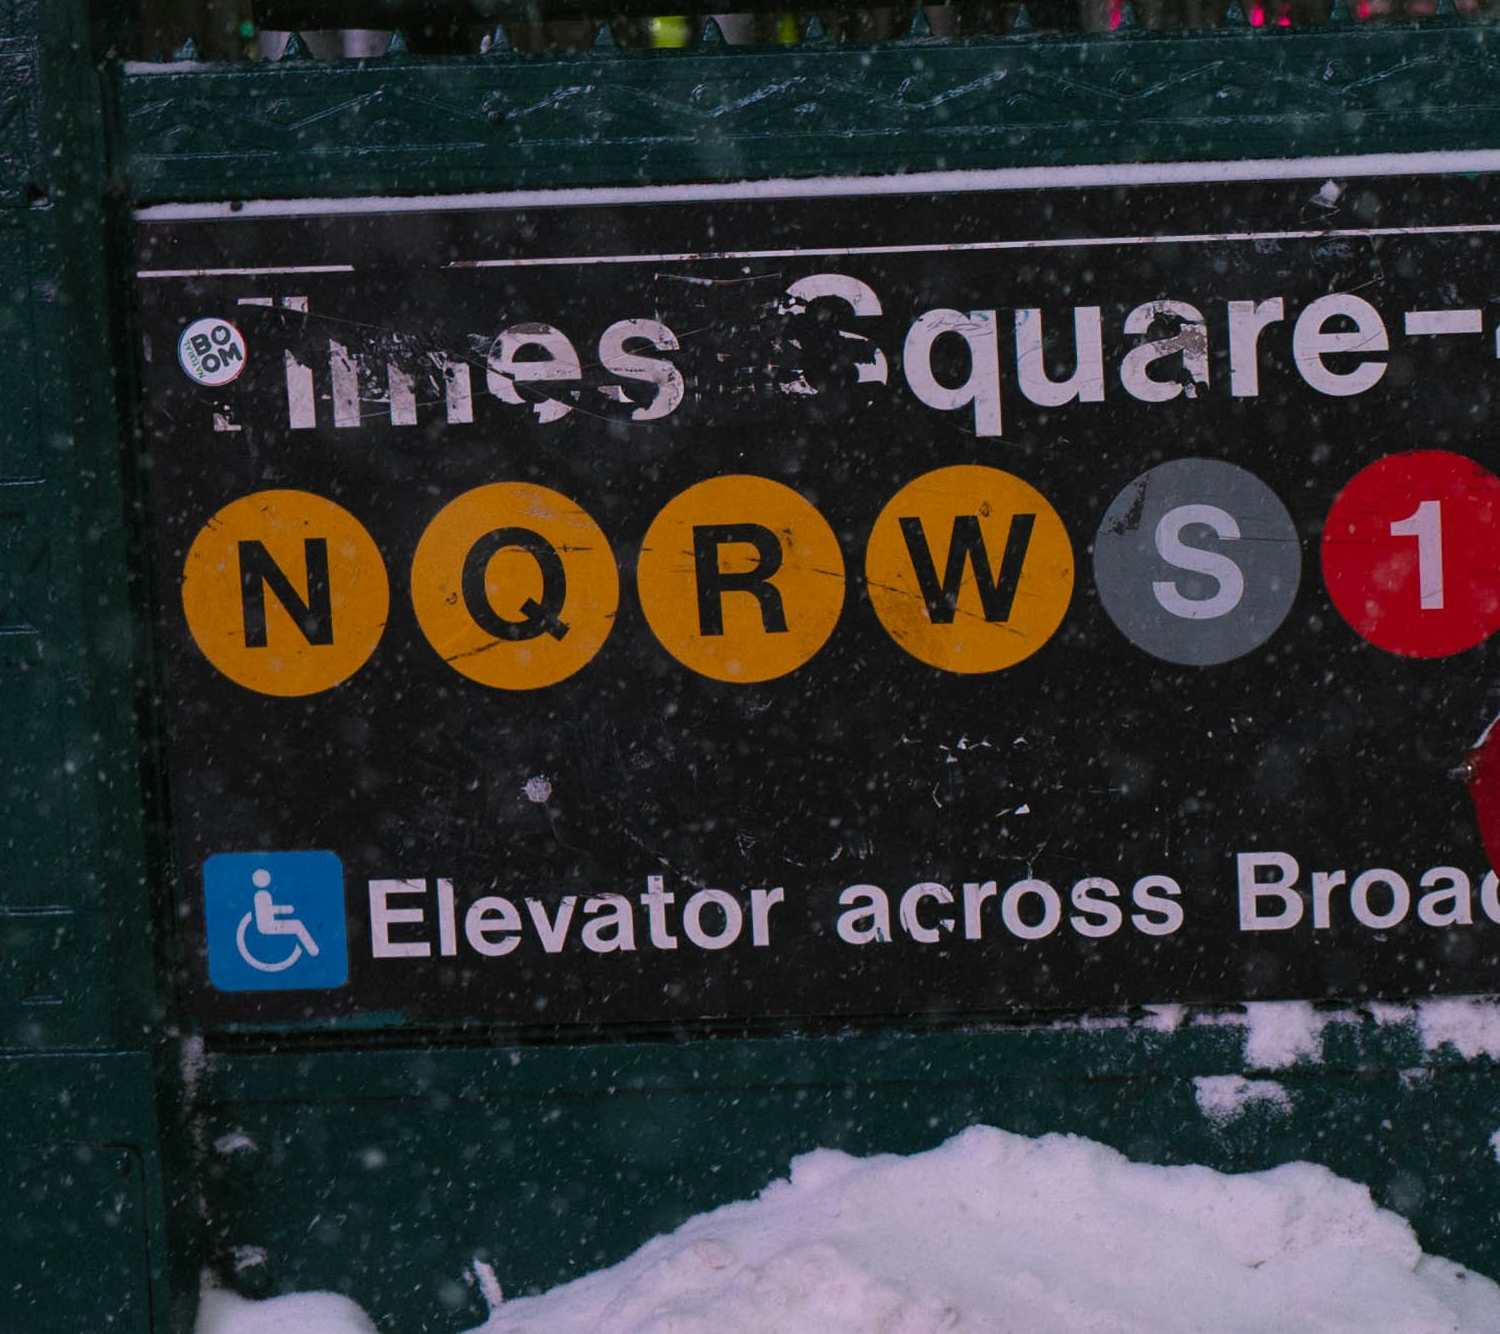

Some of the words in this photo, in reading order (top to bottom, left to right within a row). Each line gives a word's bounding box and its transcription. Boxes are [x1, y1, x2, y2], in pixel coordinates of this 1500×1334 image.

[237, 537, 335, 648] N
[461, 526, 570, 642] Q
[692, 522, 790, 637] R
[898, 513, 1036, 625] W
[1151, 503, 1246, 620] S
[1388, 500, 1444, 610] 1
[368, 875, 786, 959] Elevator
[837, 875, 1185, 945] across
